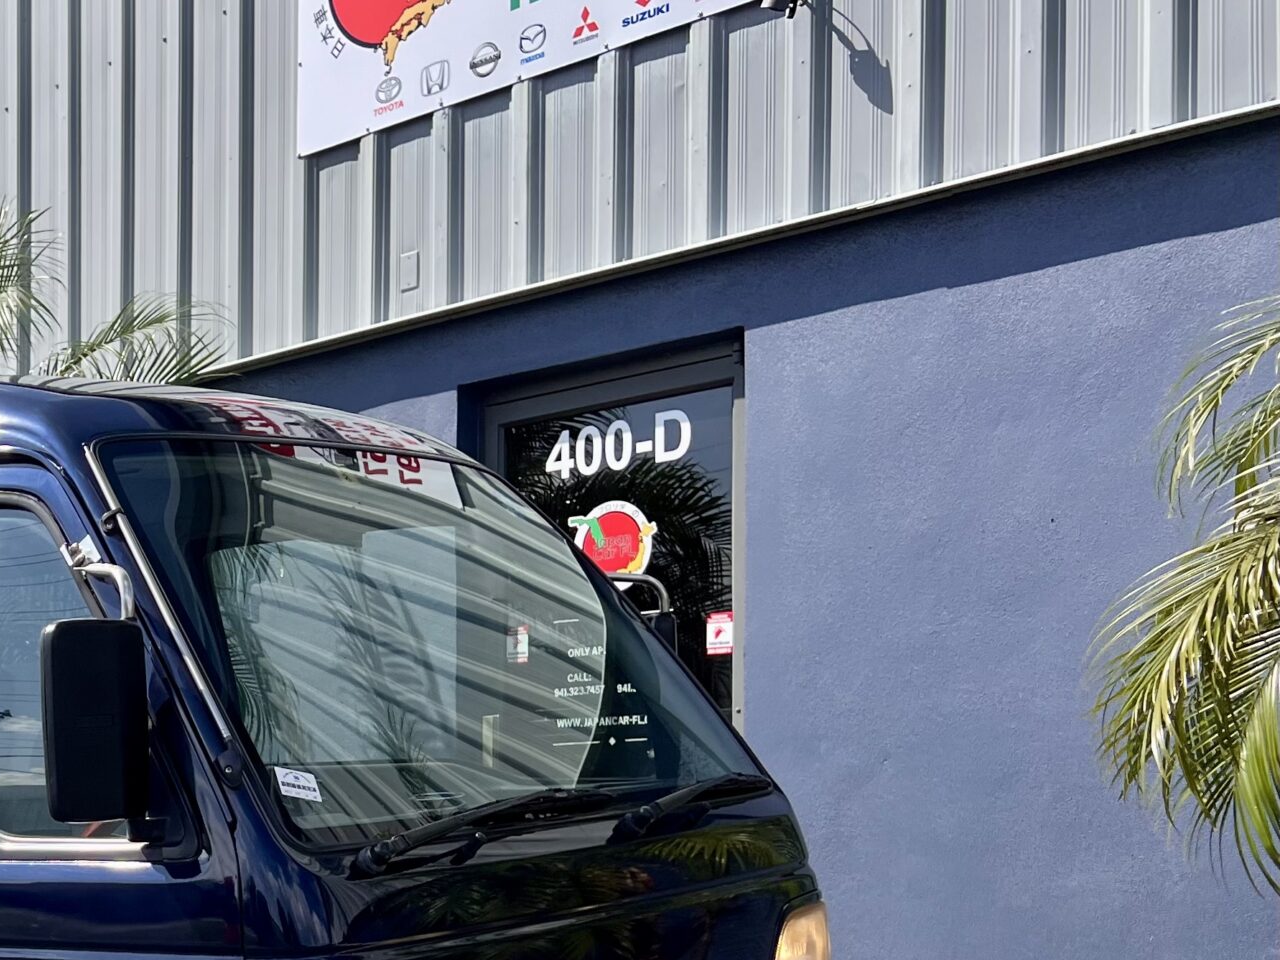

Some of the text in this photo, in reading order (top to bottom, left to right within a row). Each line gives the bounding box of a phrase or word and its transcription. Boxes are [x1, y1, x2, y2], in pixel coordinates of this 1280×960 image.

[621, 3, 670, 28] SUZUKI
[471, 54, 499, 68] NISSAN
[519, 51, 545, 66] mazda
[373, 100, 404, 117] TOYOTA
[545, 409, 692, 480] 400-D
[567, 646, 591, 658] ONLY
[567, 672, 592, 683] CALL:
